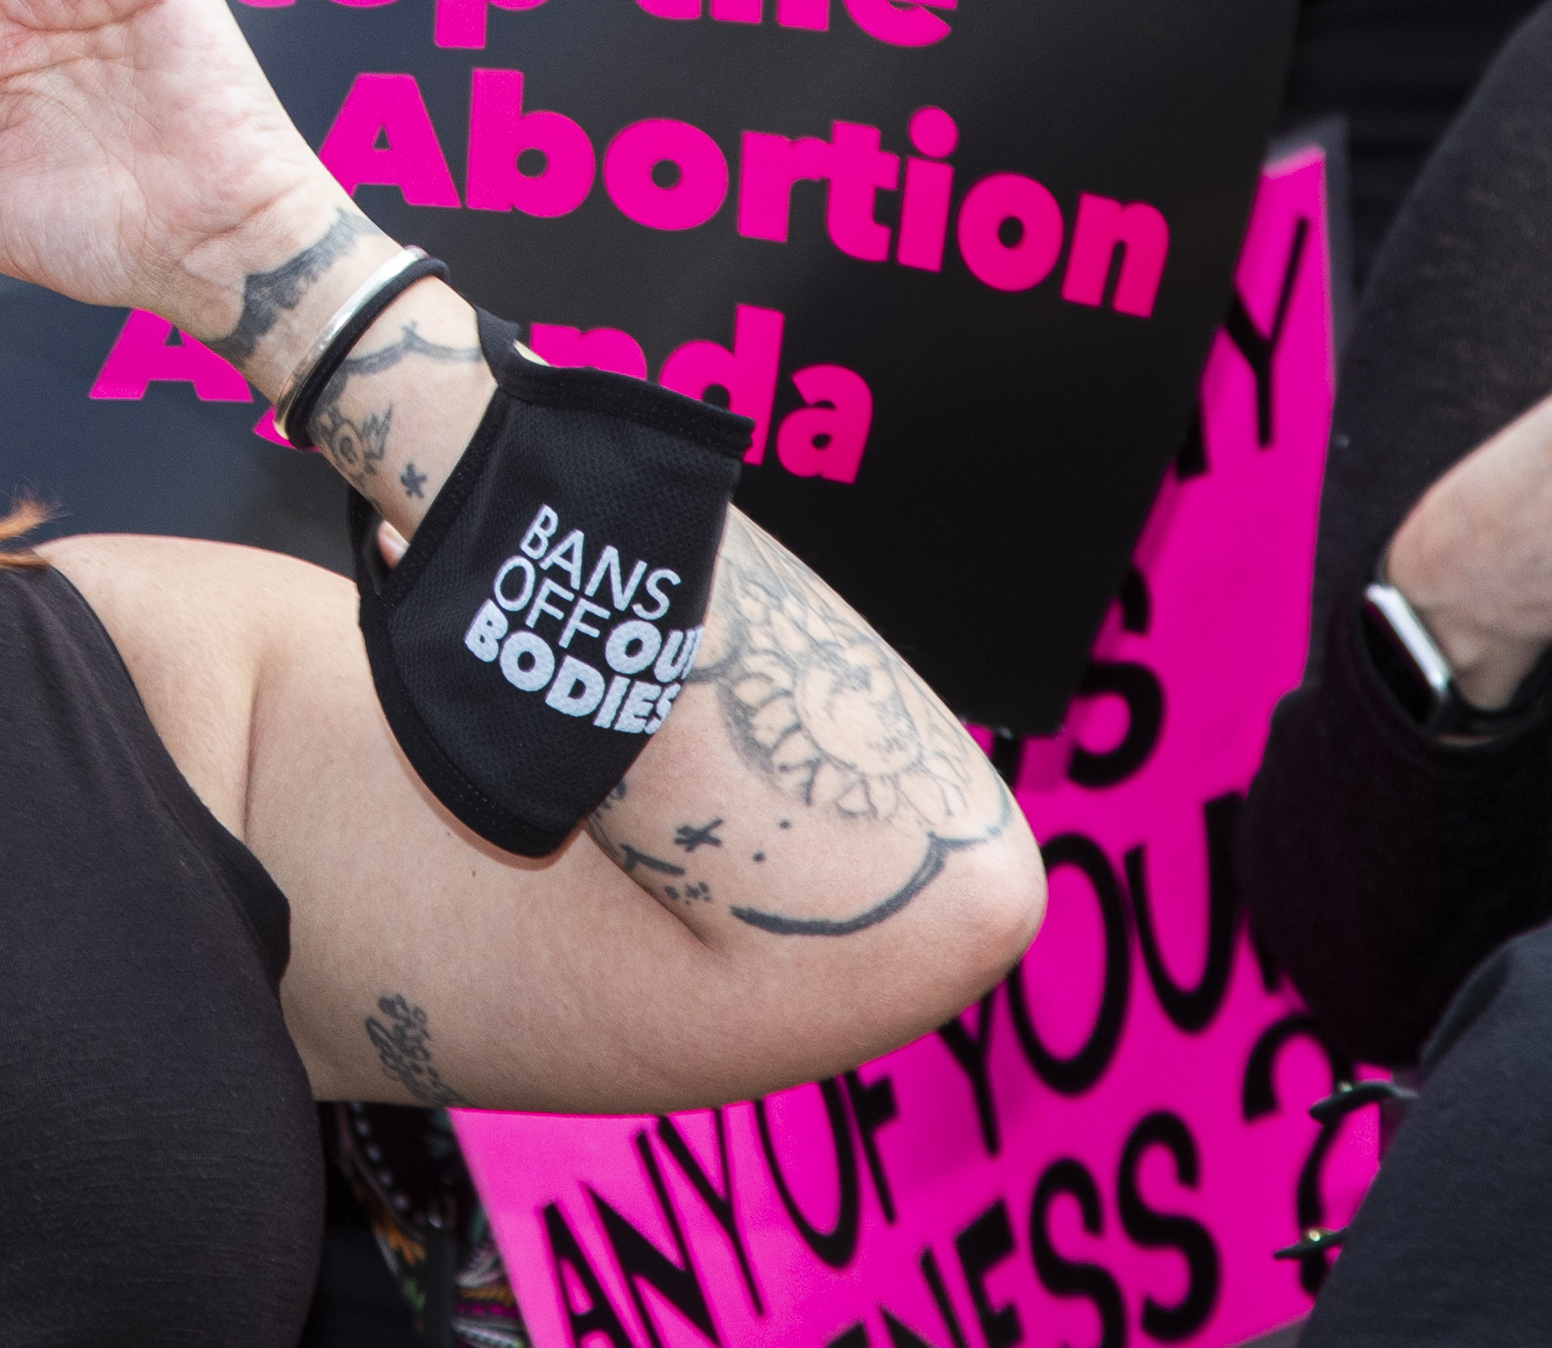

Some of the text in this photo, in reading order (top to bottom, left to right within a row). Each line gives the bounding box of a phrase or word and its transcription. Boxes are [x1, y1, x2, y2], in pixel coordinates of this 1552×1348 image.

[314, 67, 1171, 320] Abortion
[493, 554, 613, 650] OFF
[518, 503, 683, 621] BANS
[463, 597, 683, 736] BODIES
[934, 789, 1281, 1161] YOU
